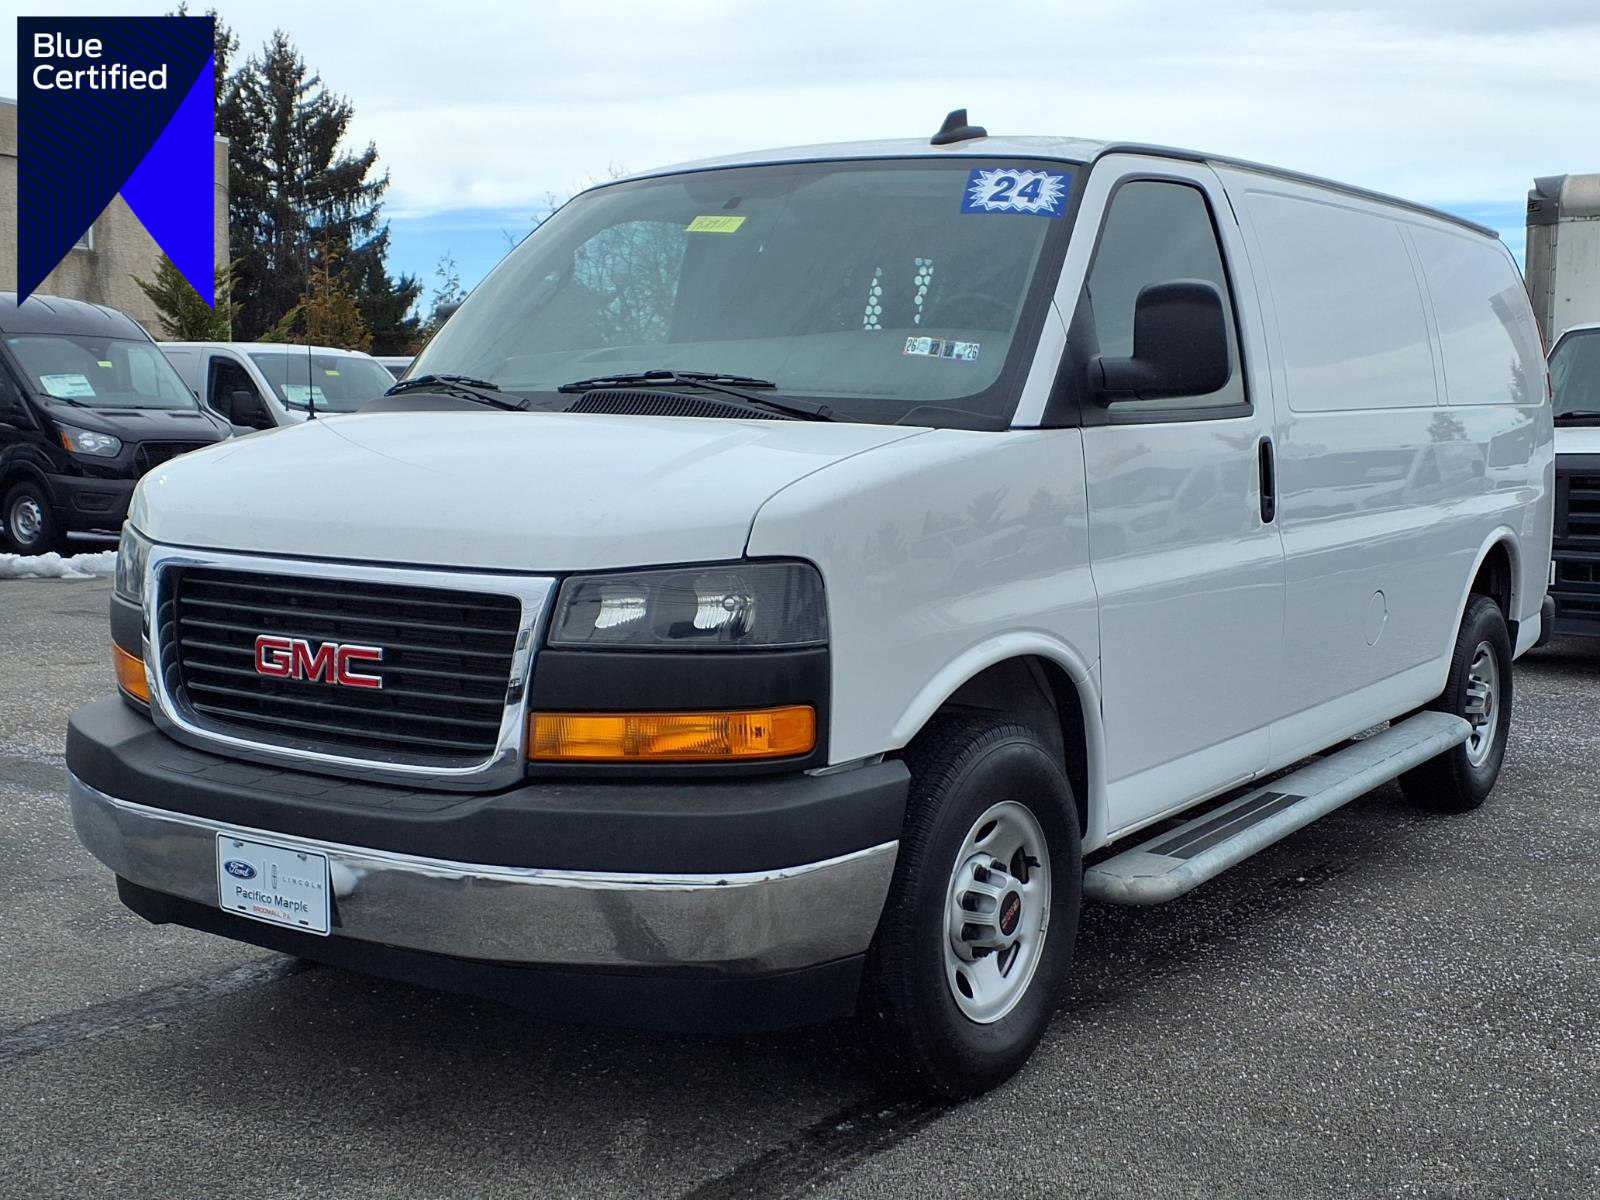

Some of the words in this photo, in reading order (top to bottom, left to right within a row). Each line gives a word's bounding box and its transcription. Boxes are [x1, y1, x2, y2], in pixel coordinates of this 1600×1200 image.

[987, 175, 1043, 203] 24
[906, 338, 918, 352] 26
[967, 344, 978, 359] 26
[254, 634, 384, 689] GMC
[282, 876, 322, 890] LINCOLN
[235, 886, 272, 905] Pacifico
[274, 895, 309, 913] Marple
